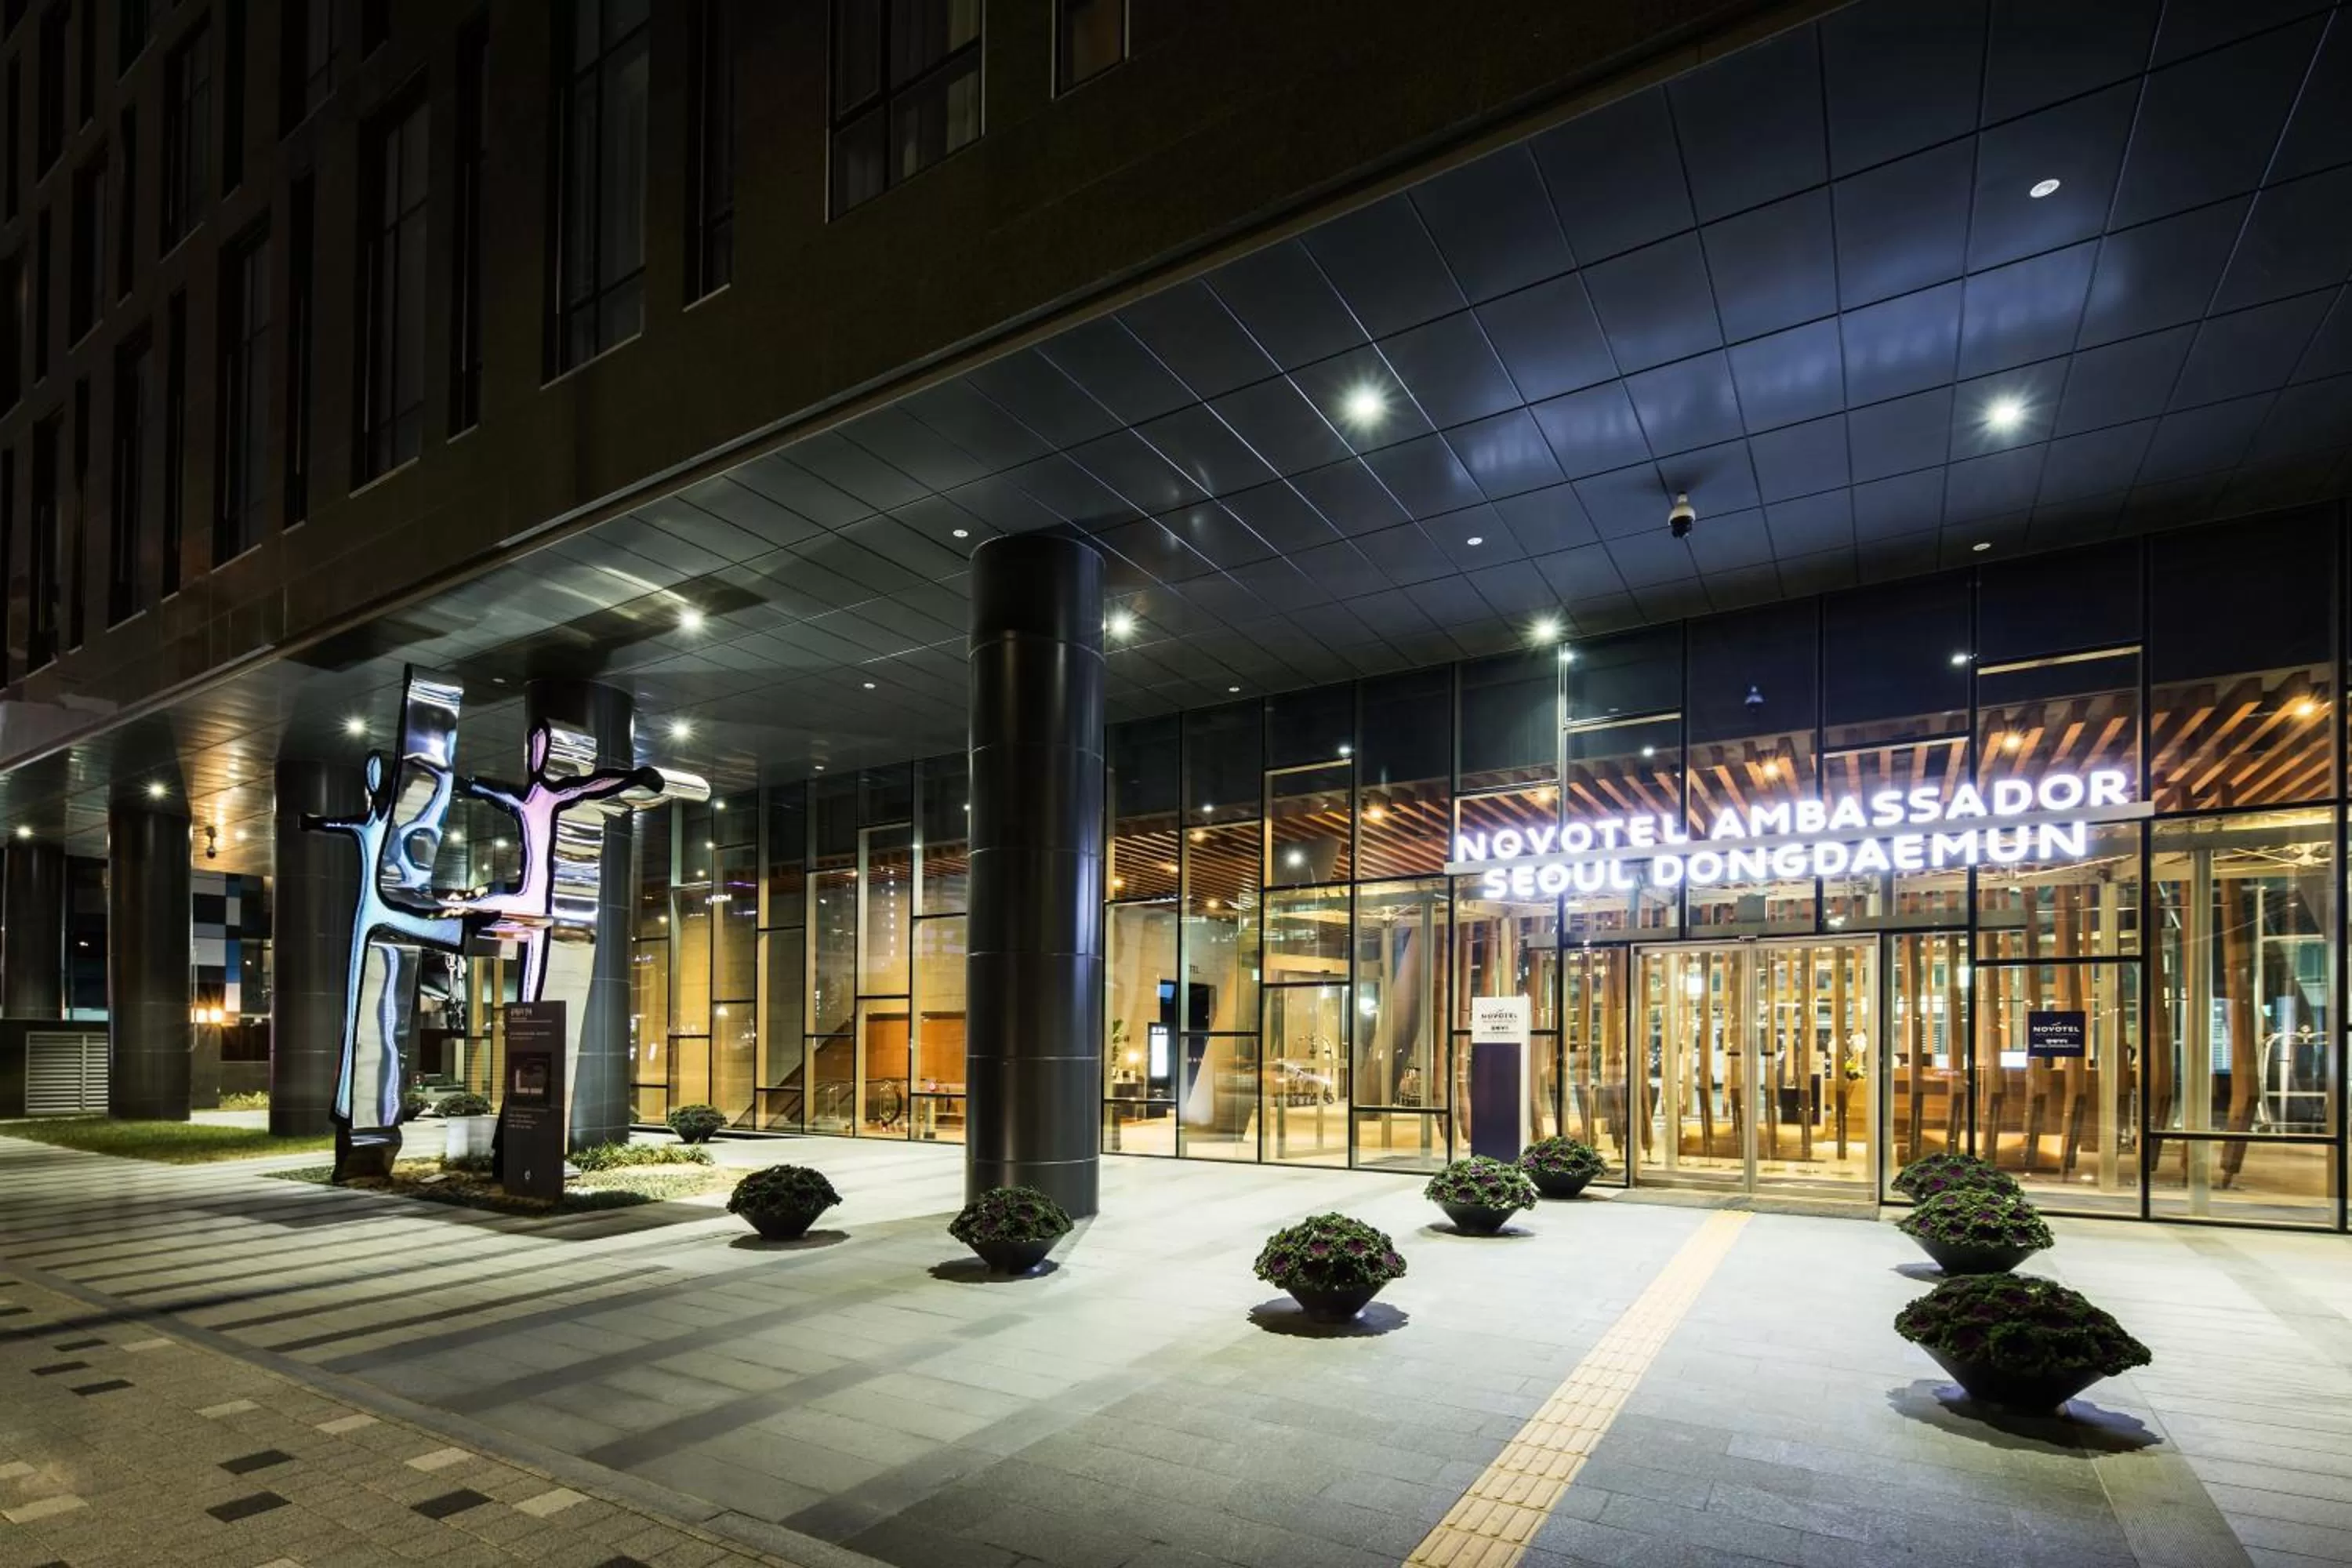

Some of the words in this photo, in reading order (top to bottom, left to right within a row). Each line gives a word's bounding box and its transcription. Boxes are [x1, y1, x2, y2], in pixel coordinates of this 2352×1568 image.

[1456, 814, 1687, 862] NOVOTEL
[1710, 770, 2130, 841] AMBASSADOR
[1483, 858, 1635, 898] SEOUL
[1652, 820, 2086, 887] DONGDAEMUN
